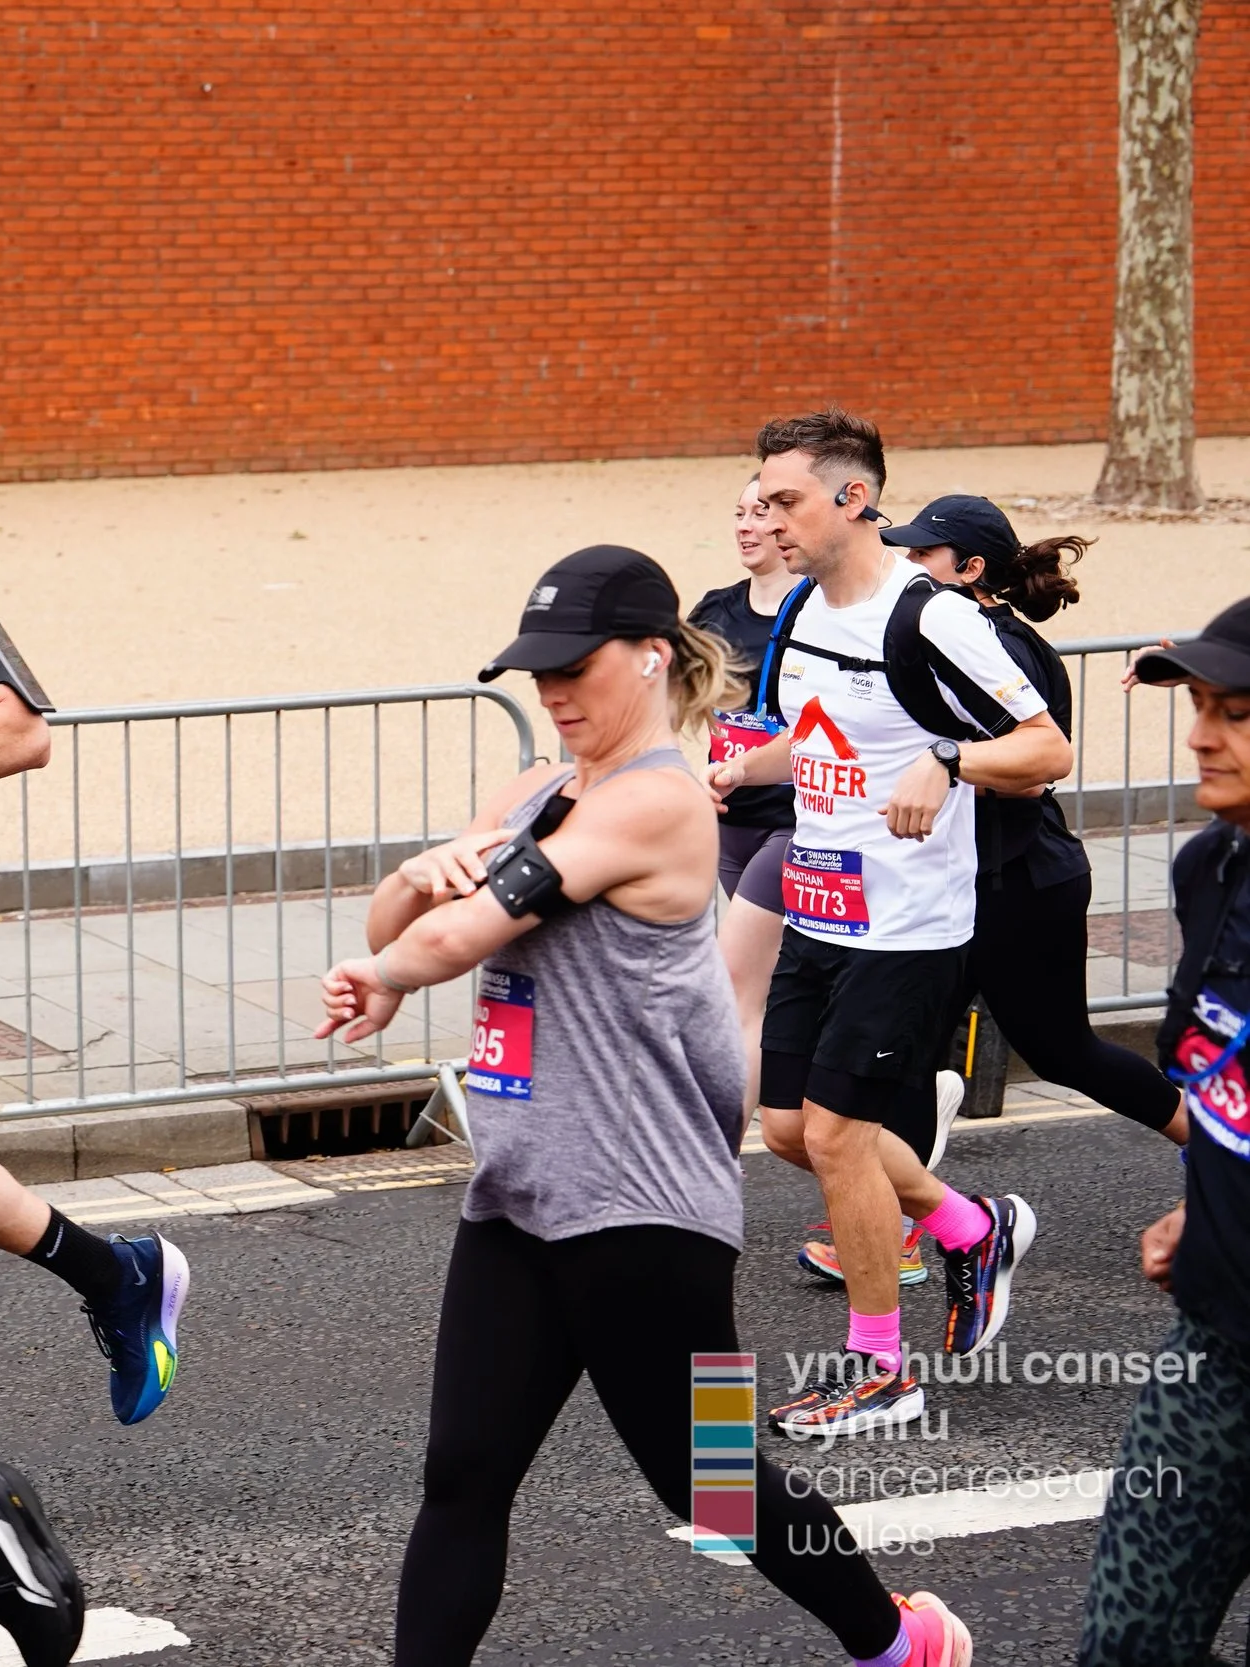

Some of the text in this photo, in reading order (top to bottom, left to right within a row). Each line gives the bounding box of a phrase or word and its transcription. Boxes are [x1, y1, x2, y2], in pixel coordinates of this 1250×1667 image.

[791, 753, 867, 798] HELTER
[798, 790, 834, 816] YMRU
[808, 850, 842, 862] SWANSEA
[783, 867, 823, 887] JONATHAN
[794, 883, 847, 917] 7773
